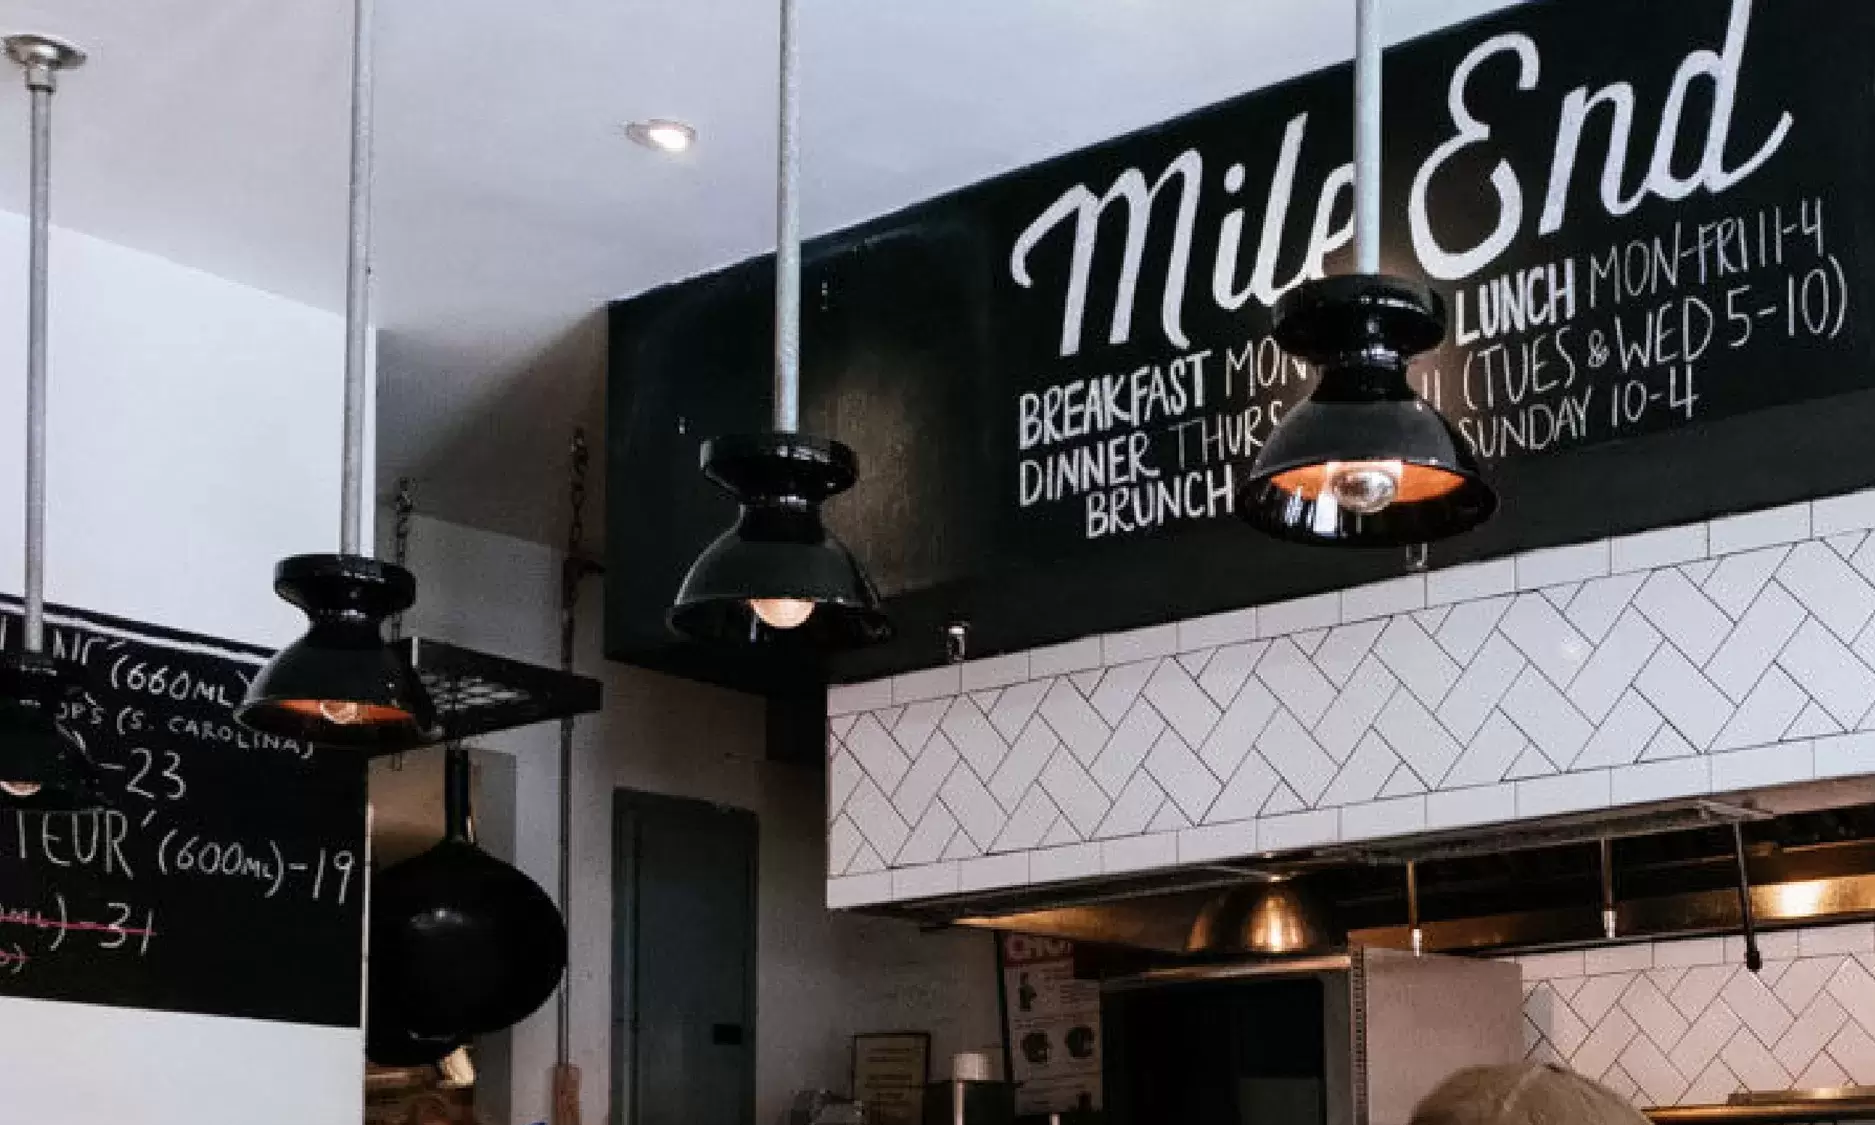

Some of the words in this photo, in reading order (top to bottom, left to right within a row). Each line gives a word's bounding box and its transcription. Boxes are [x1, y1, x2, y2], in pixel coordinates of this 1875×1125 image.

[1408, 0, 1795, 281] End
[1018, 349, 1213, 450] BREAKFAST
[1455, 257, 1576, 346] LUNCH
[1019, 431, 1161, 507] DINNER
[1463, 325, 1577, 412] (TUES
[1587, 328, 1610, 369] &
[1613, 296, 1715, 373] WED
[1726, 253, 1849, 349] 5-10)
[1085, 464, 1236, 539] BRUNCH
[1457, 385, 1592, 458] SUNDAY
[1610, 363, 1699, 428] 10-4
